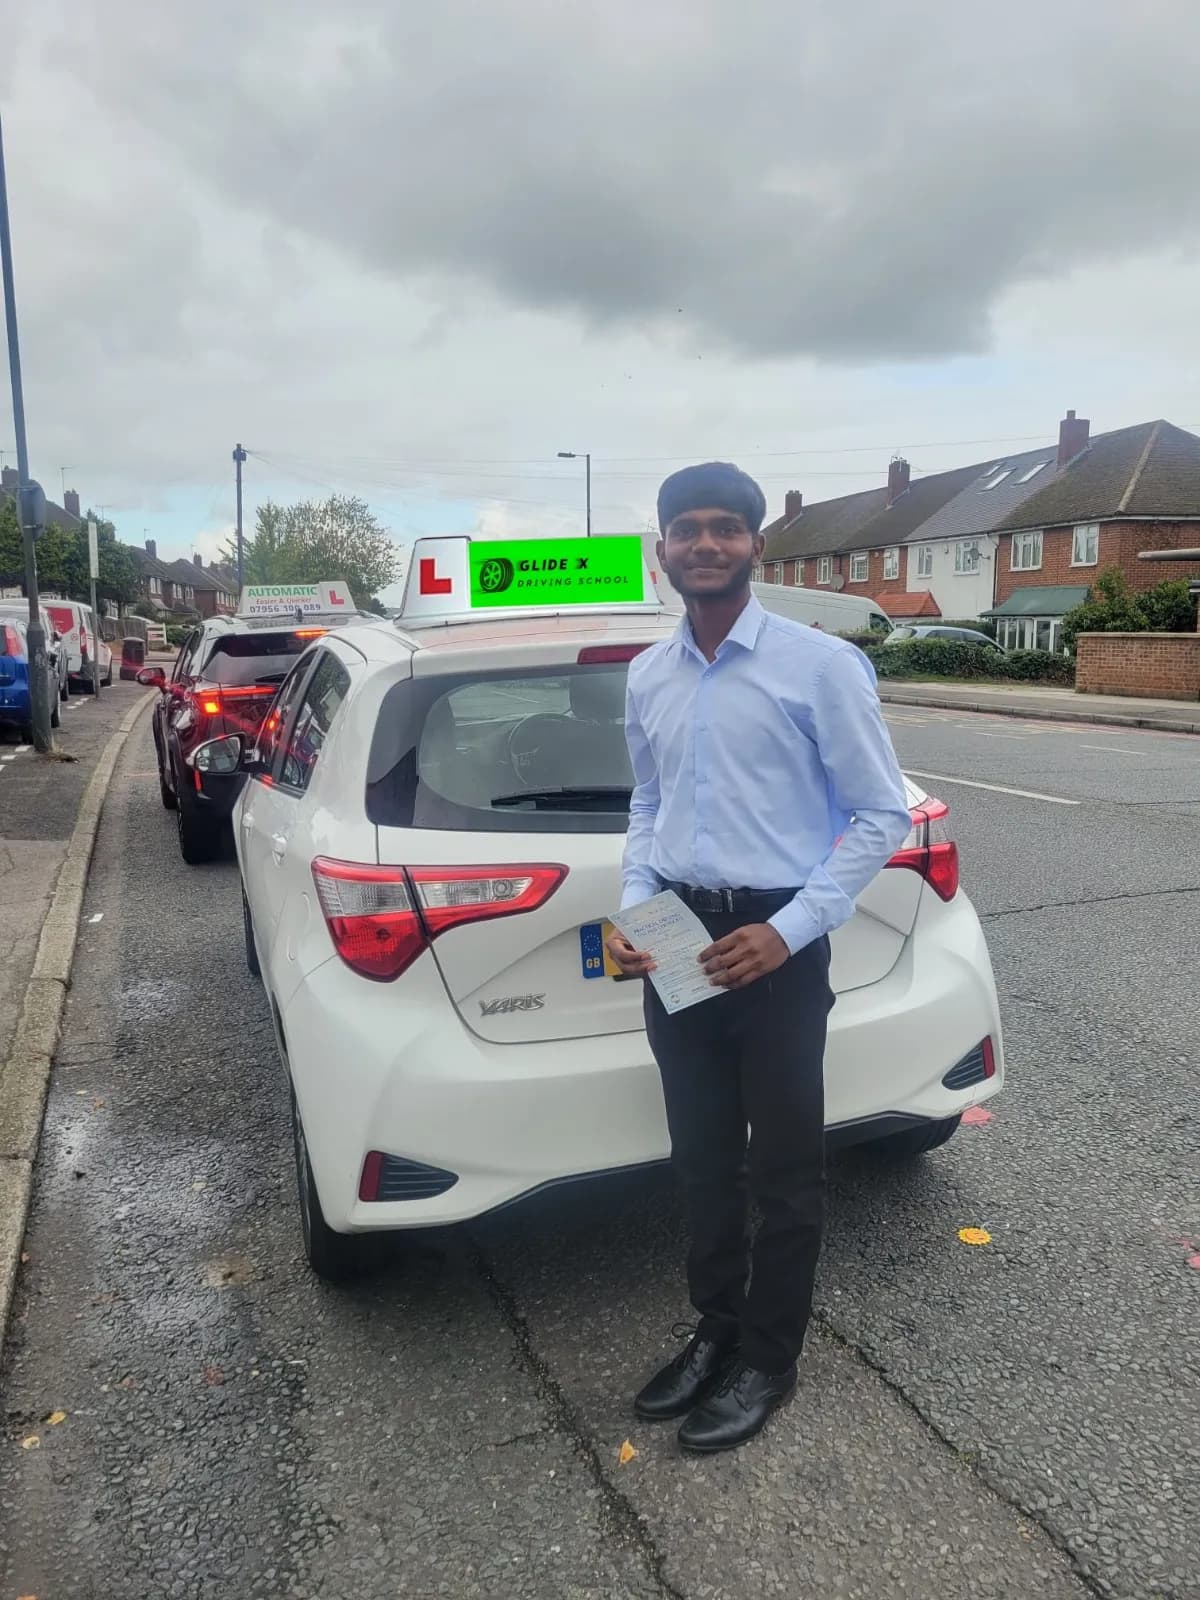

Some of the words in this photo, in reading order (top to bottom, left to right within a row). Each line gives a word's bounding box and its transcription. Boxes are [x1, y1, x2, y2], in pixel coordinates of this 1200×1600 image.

[519, 559, 568, 572] GLIDE
[576, 557, 589, 570] X
[420, 558, 451, 595] L
[517, 577, 572, 588] DRIVING
[578, 576, 629, 586] SCHOOL
[248, 587, 318, 597] AUTOMATIC
[329, 590, 344, 604] L
[586, 958, 600, 969] GB
